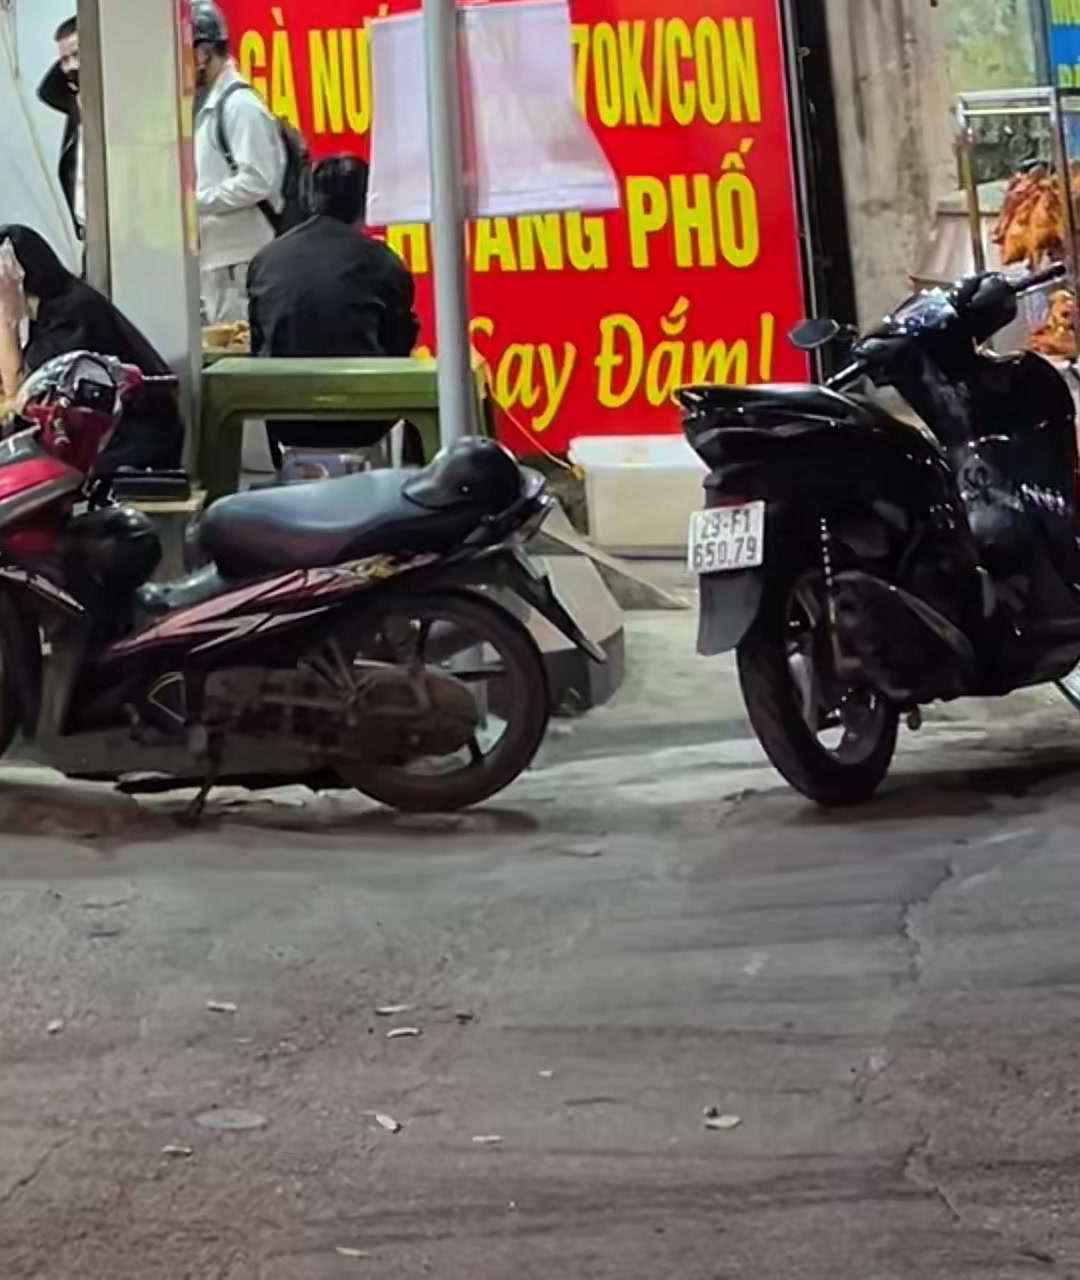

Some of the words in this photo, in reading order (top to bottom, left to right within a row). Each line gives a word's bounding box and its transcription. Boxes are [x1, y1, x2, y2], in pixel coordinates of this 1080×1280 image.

[571, 15, 762, 129] 70K/CON
[626, 138, 759, 268] PHỐ
[594, 295, 776, 410] Đắm!
[693, 536, 758, 569] 650.79
